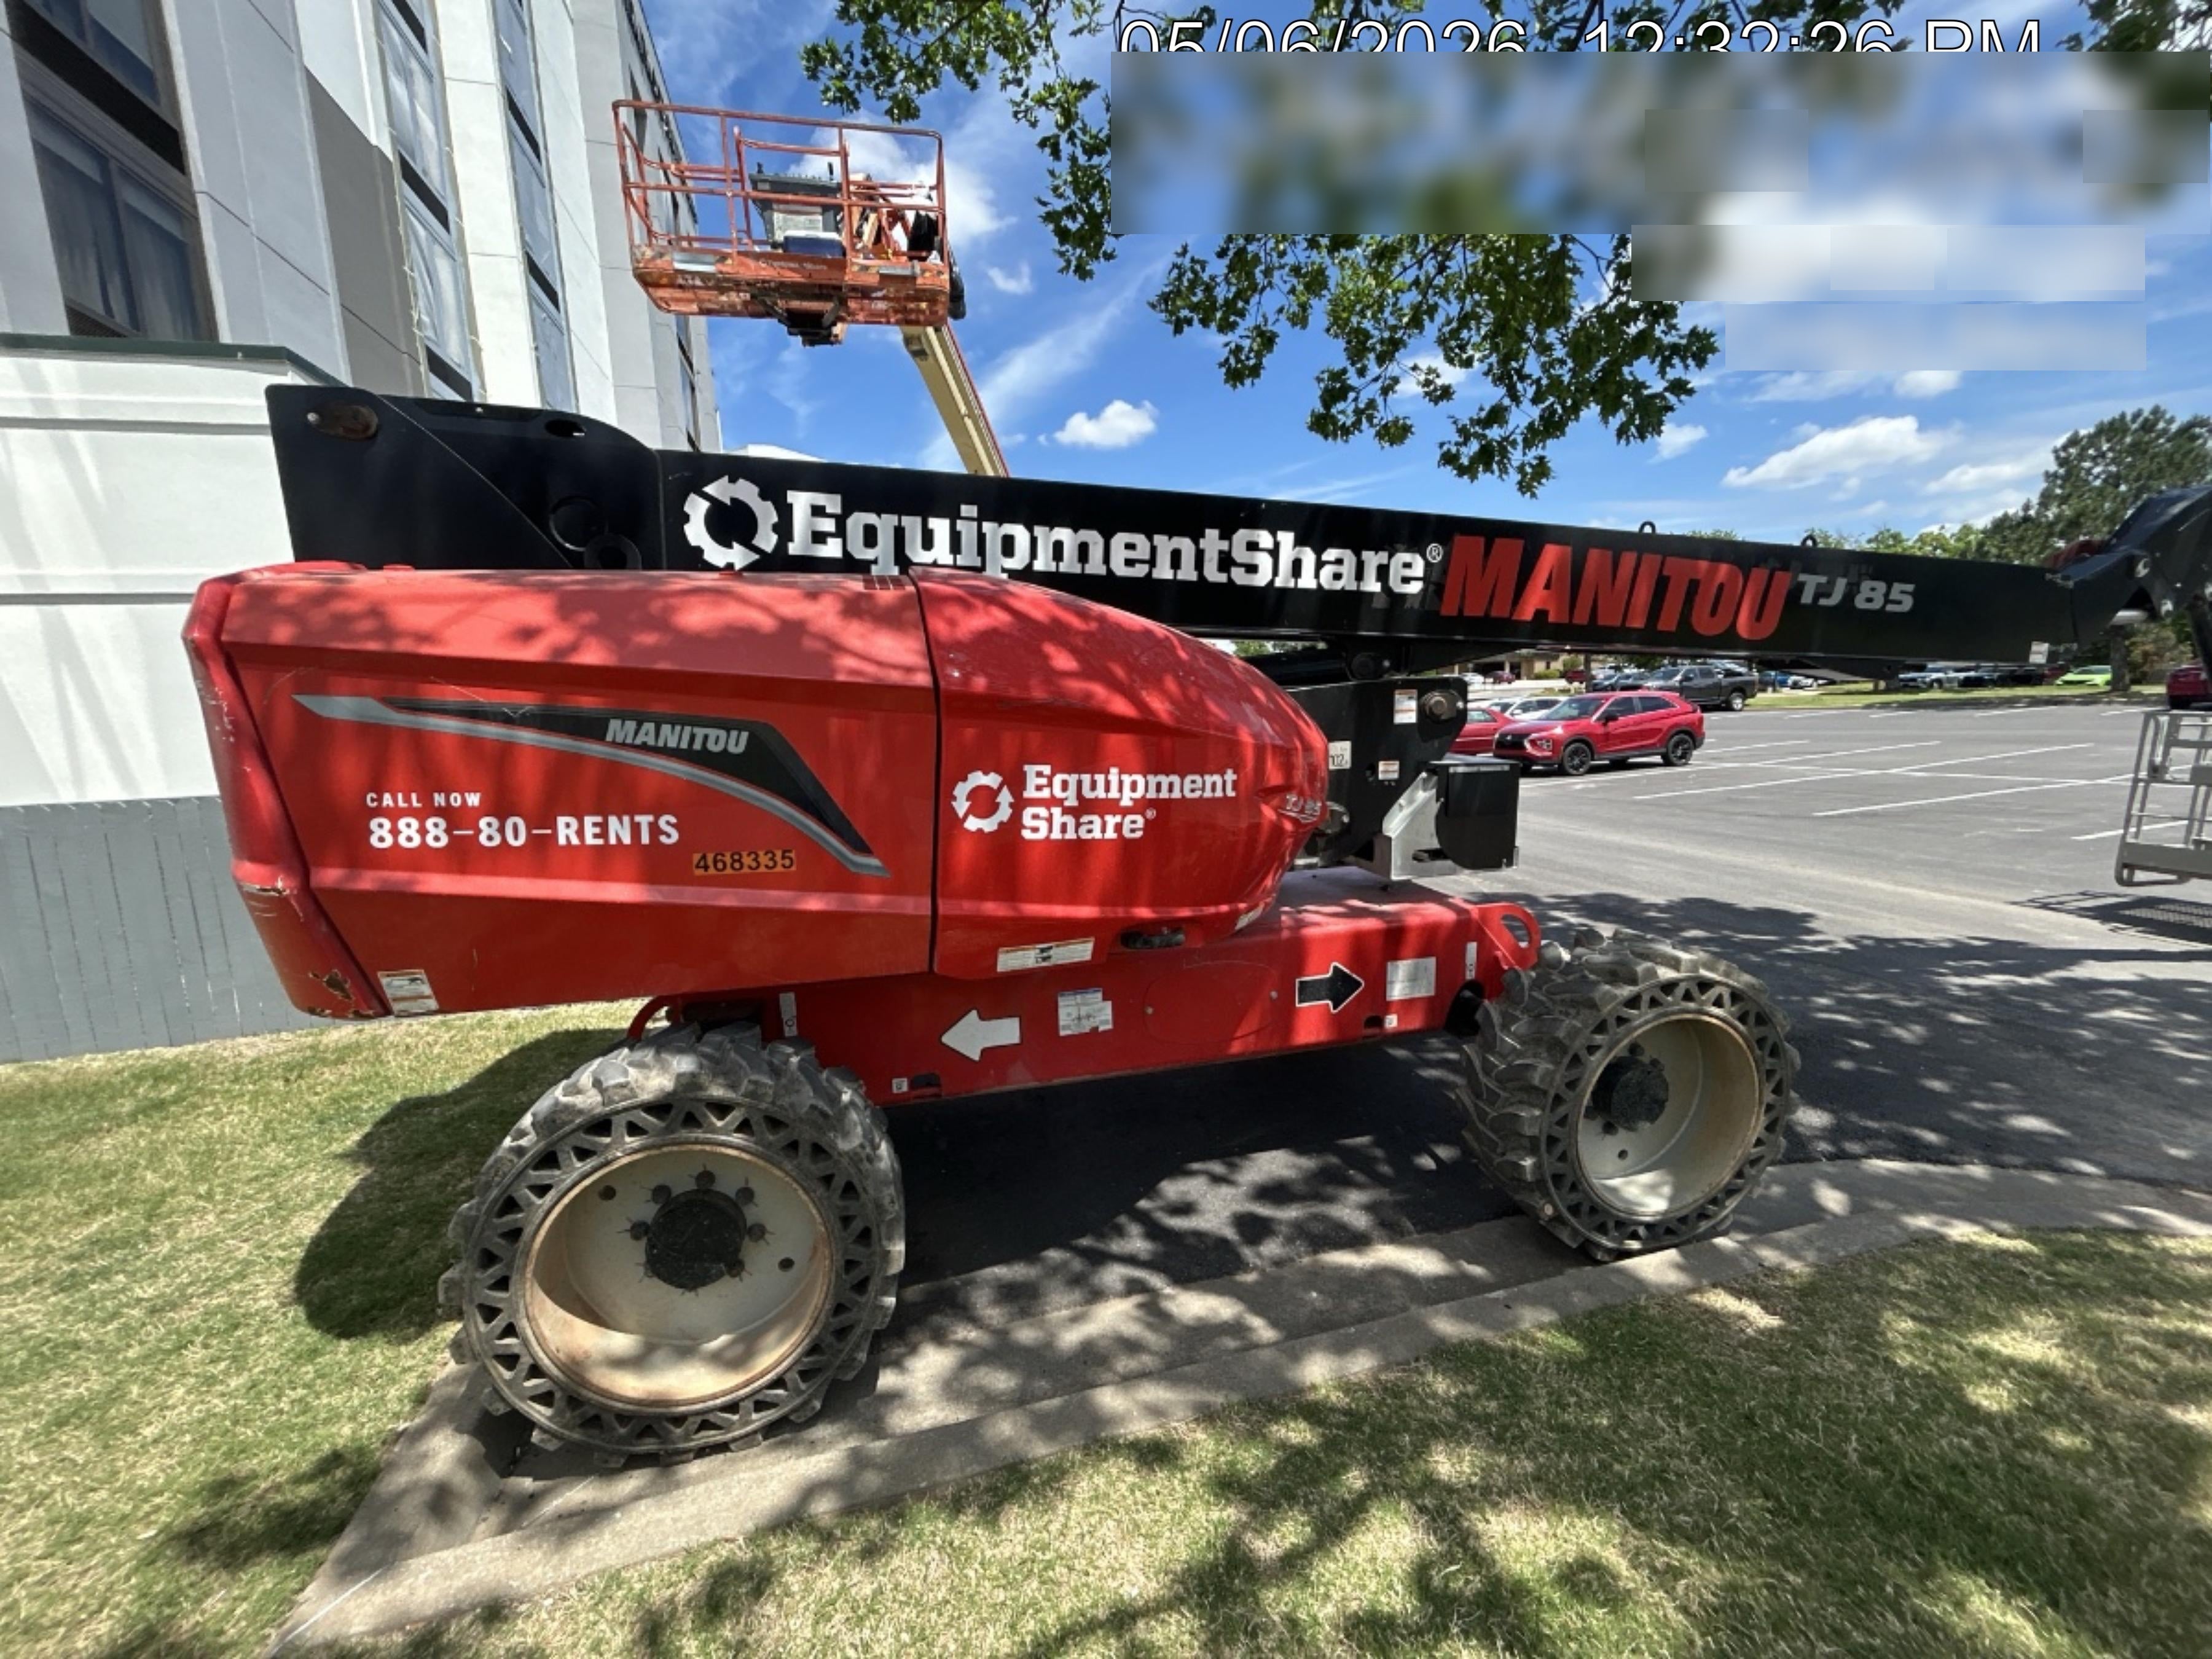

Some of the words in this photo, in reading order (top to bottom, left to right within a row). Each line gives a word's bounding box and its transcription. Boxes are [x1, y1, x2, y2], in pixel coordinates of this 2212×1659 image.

[1440, 535, 1793, 641] MANITOU
[1797, 573, 1848, 607] TJ
[1853, 579, 1916, 613] 85
[605, 718, 750, 755] MANITOU
[366, 792, 422, 809] CALL
[433, 791, 482, 808] NOW
[1022, 764, 1237, 807] Equipment
[369, 814, 680, 849] 888-80-RENTS
[694, 849, 795, 874] 468335
